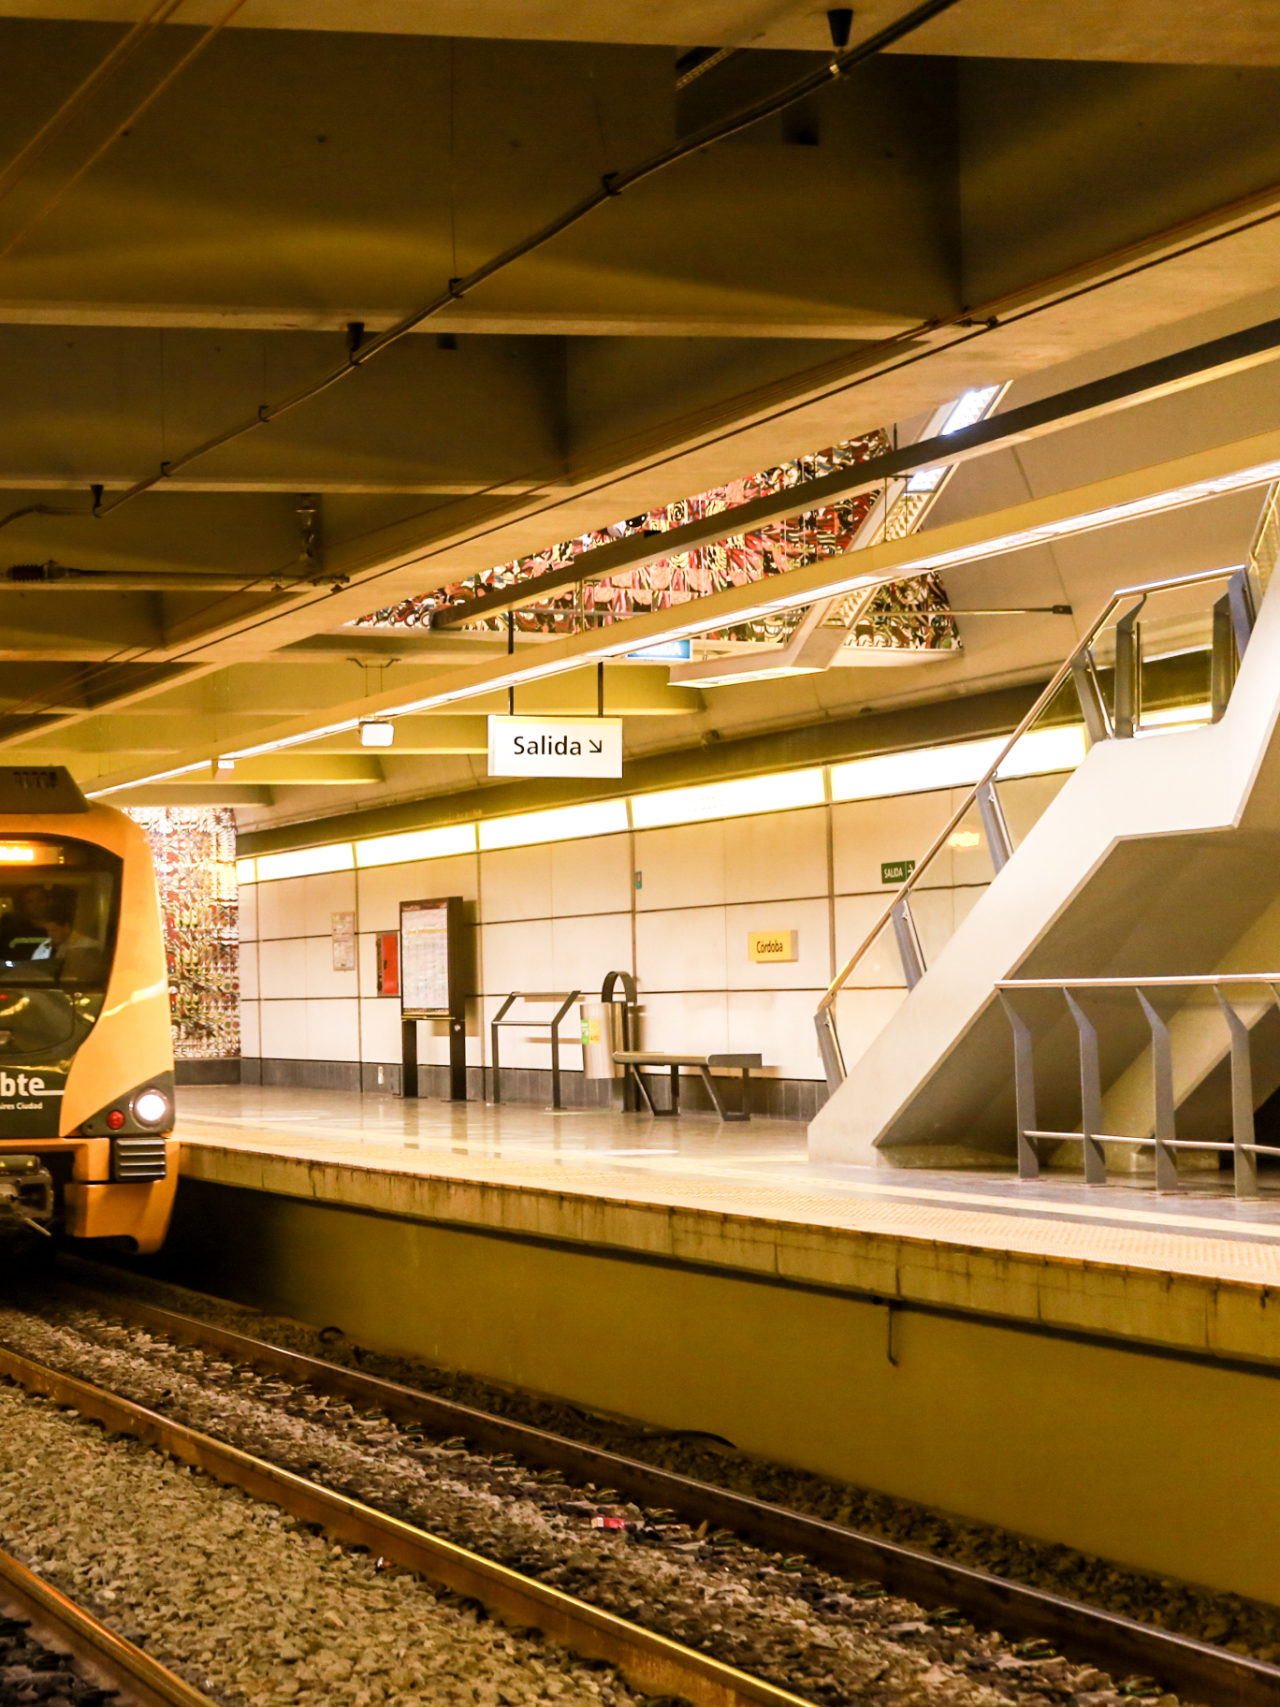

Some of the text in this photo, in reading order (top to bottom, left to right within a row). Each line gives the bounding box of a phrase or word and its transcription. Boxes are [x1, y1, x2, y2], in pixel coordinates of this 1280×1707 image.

[513, 735, 582, 755] Salida
[884, 867, 904, 879] SALIDA
[16, 1101, 44, 1110] Ciudad
